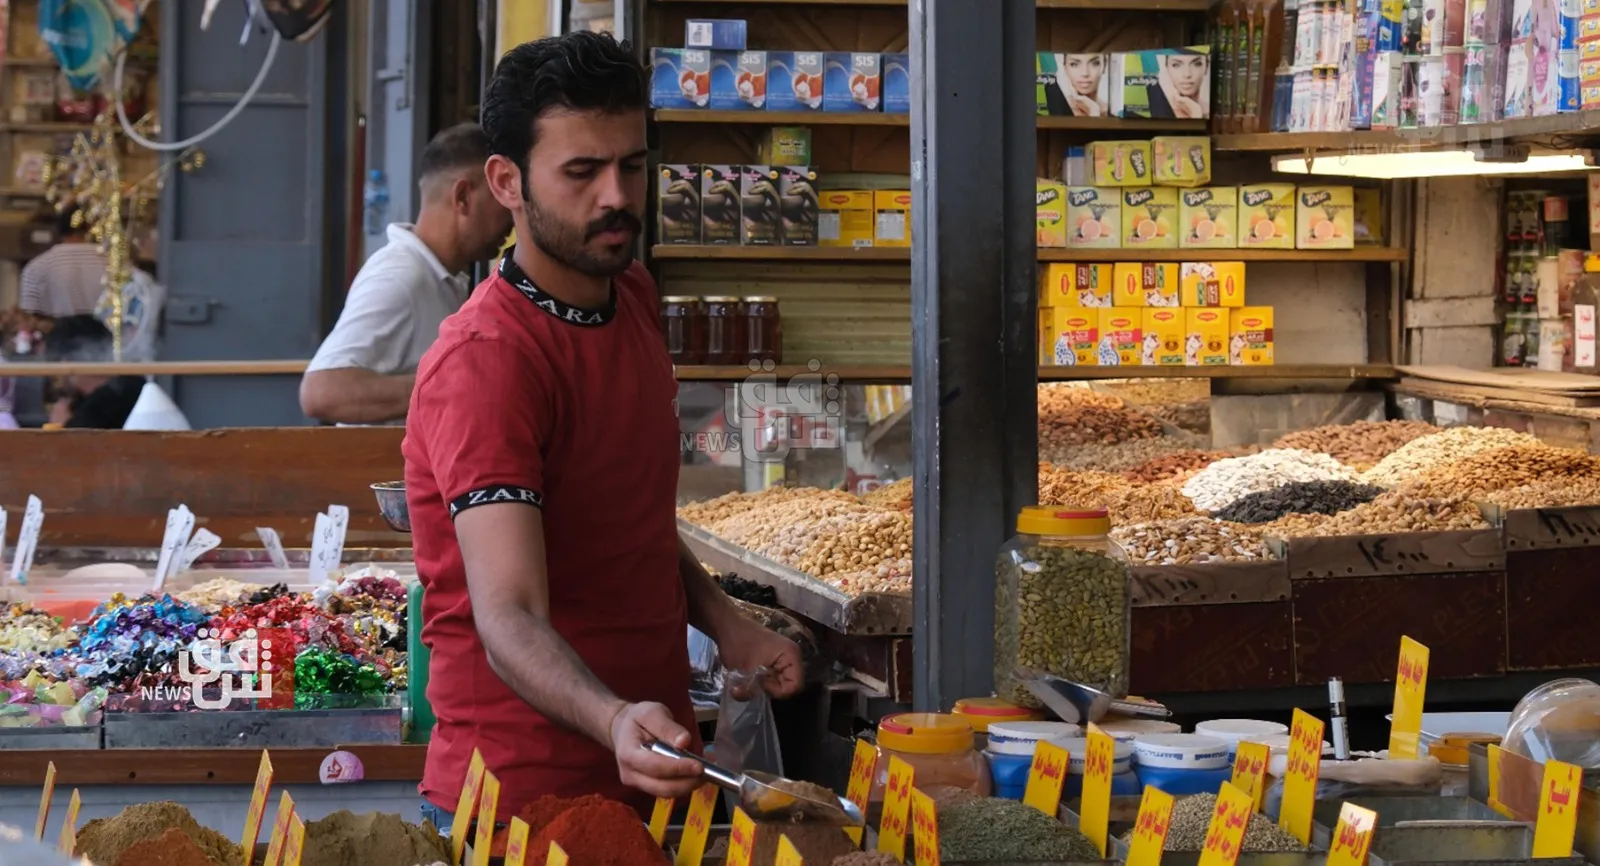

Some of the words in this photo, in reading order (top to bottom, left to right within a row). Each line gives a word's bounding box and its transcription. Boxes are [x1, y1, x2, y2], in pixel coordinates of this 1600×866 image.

[1128, 190, 1151, 205] TANG
[1187, 190, 1210, 205] TANG
[1247, 190, 1270, 205] TANG
[516, 278, 604, 325] ZARA
[468, 487, 544, 506] ZAR
